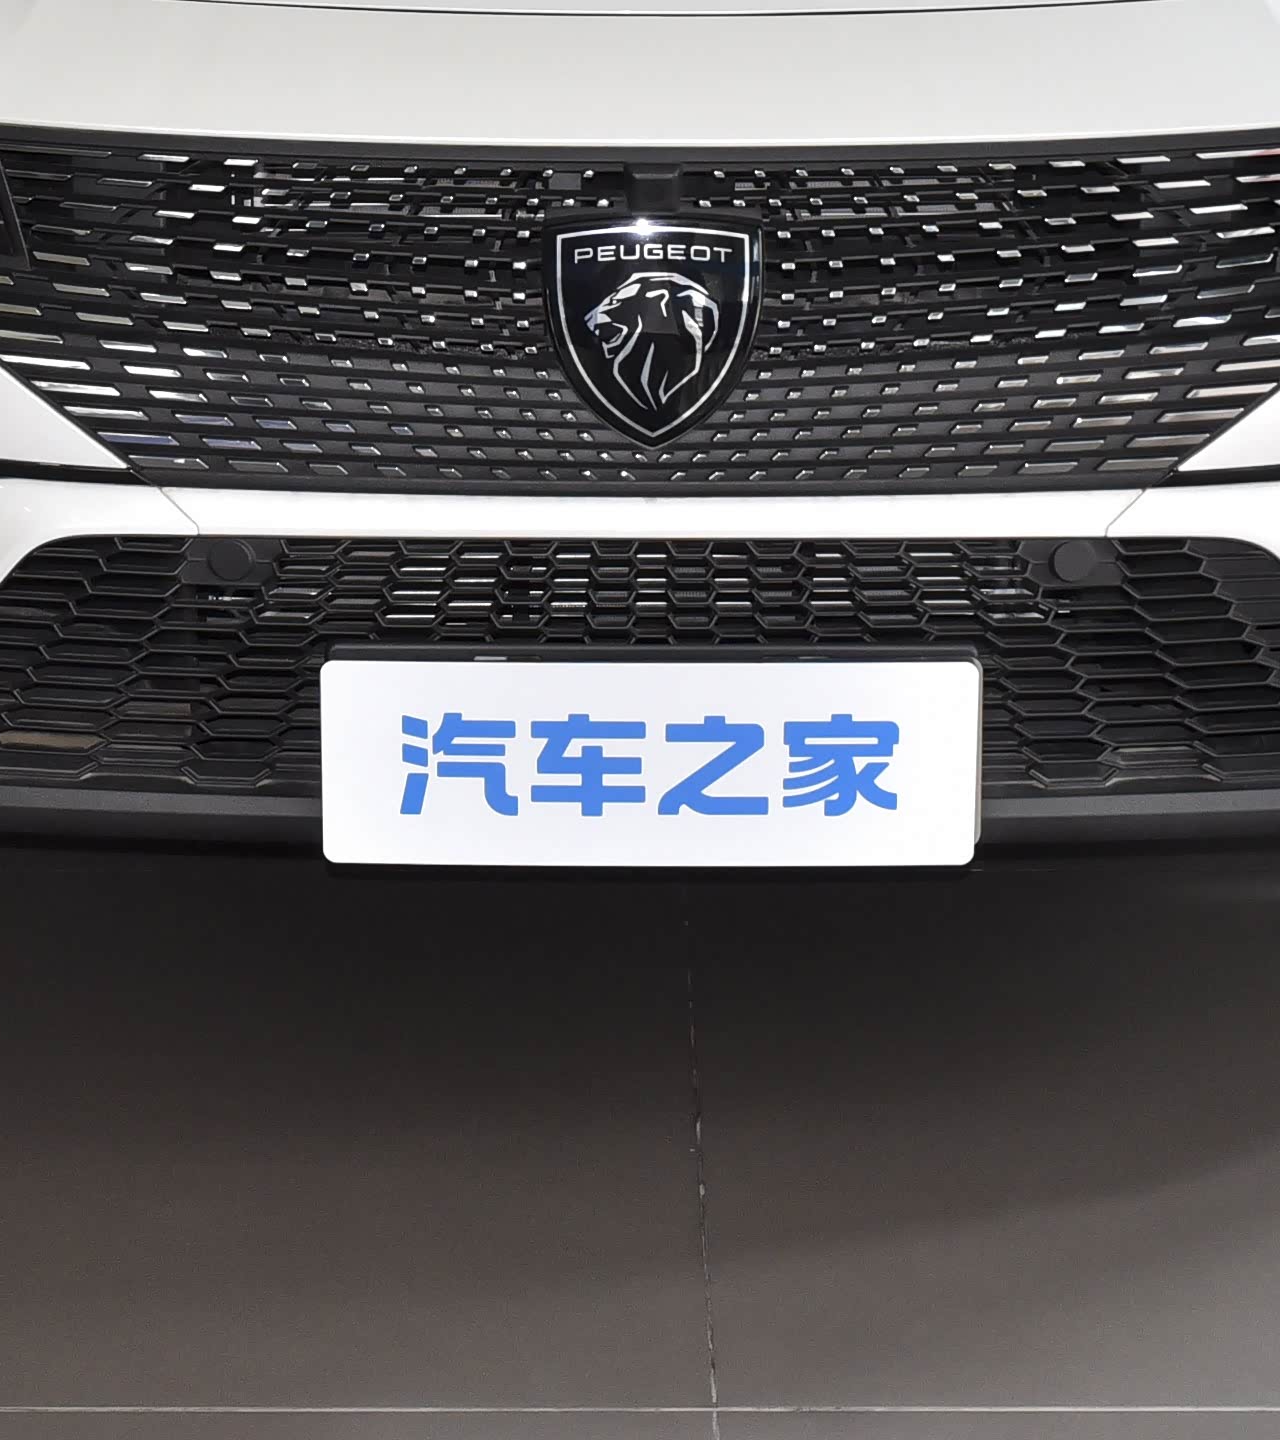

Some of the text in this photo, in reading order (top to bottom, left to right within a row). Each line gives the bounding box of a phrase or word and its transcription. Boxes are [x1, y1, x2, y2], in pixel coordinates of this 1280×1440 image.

[574, 244, 733, 264] PEUGEOT
[399, 712, 900, 817] 汽车之家
